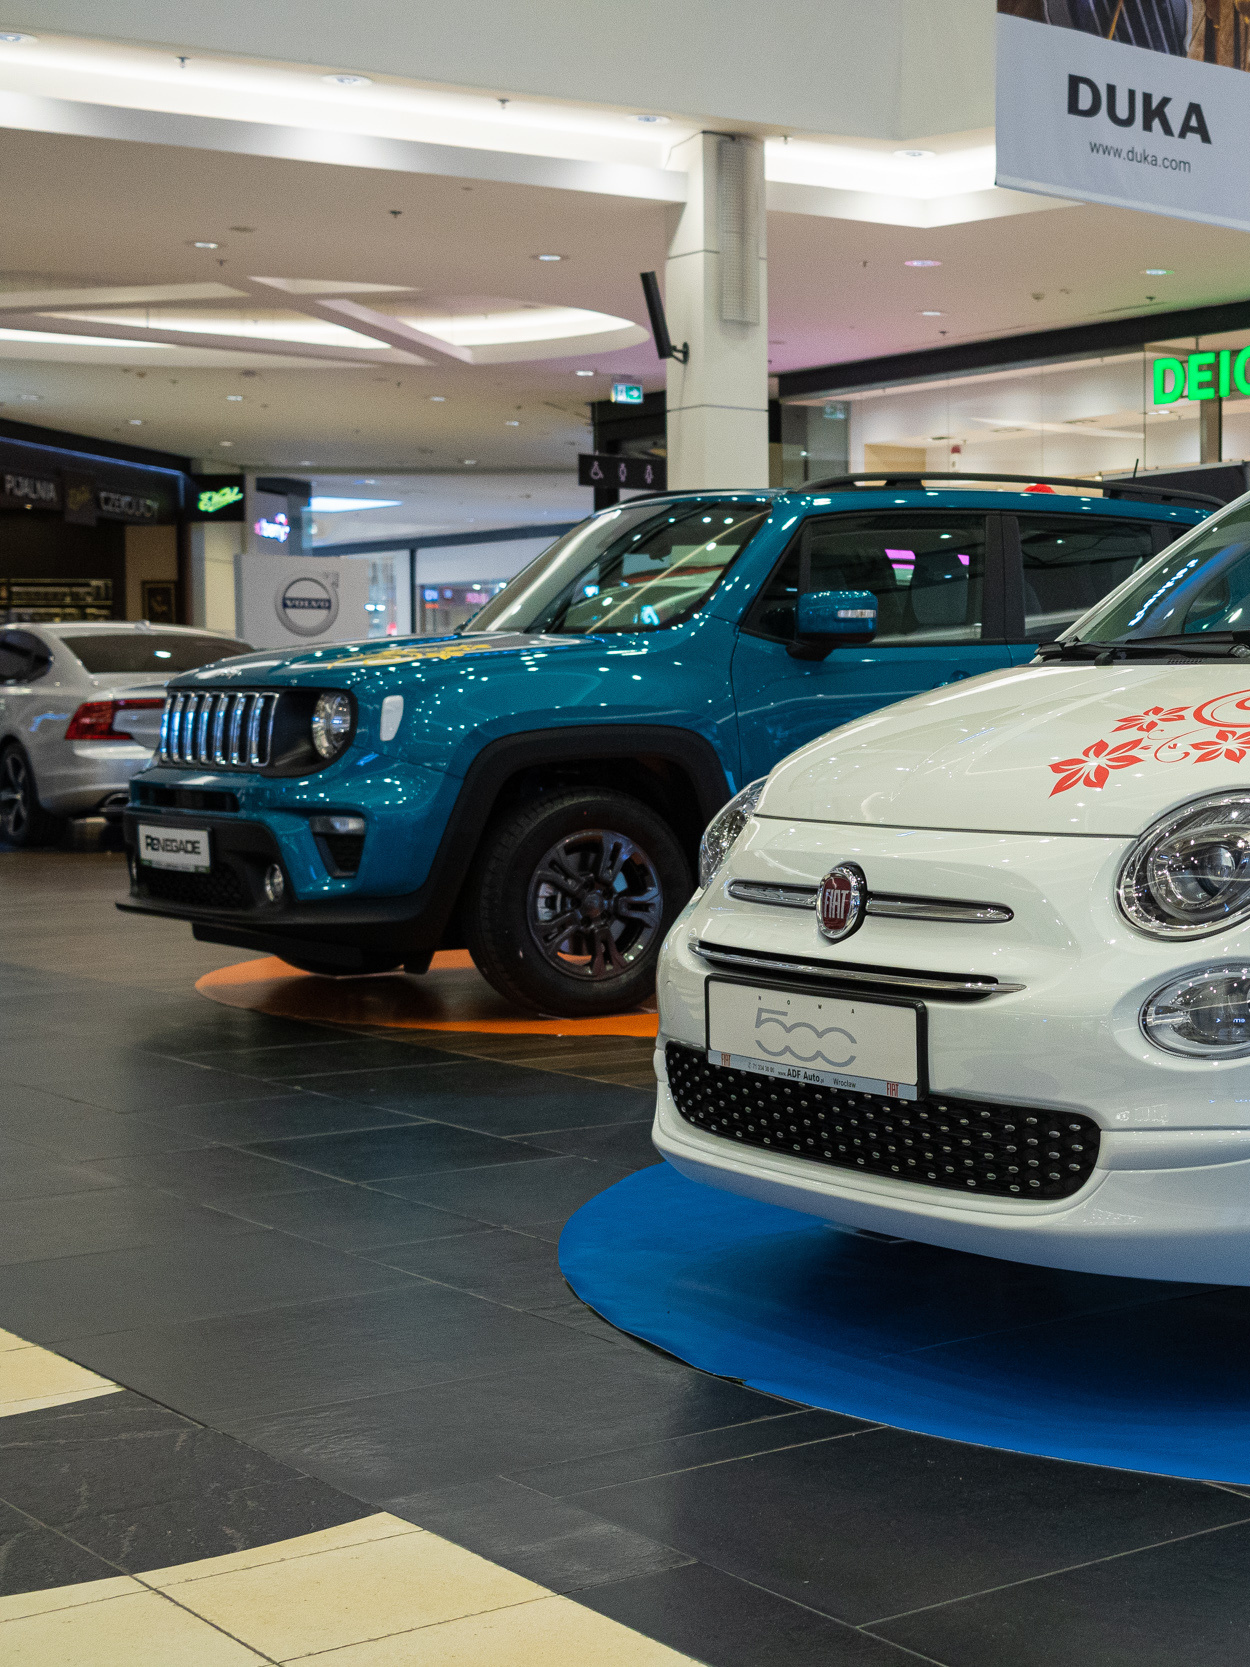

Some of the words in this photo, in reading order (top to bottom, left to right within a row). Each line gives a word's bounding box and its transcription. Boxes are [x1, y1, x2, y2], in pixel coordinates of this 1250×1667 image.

[1067, 73, 1212, 145] DUKA
[1089, 141, 1191, 173] www.duka.com
[285, 599, 330, 608] VOLVO
[145, 834, 201, 855] RENEGADE
[824, 889, 850, 919] FIAT
[755, 1007, 857, 1067] 500
[886, 1082, 899, 1098] FIAT
